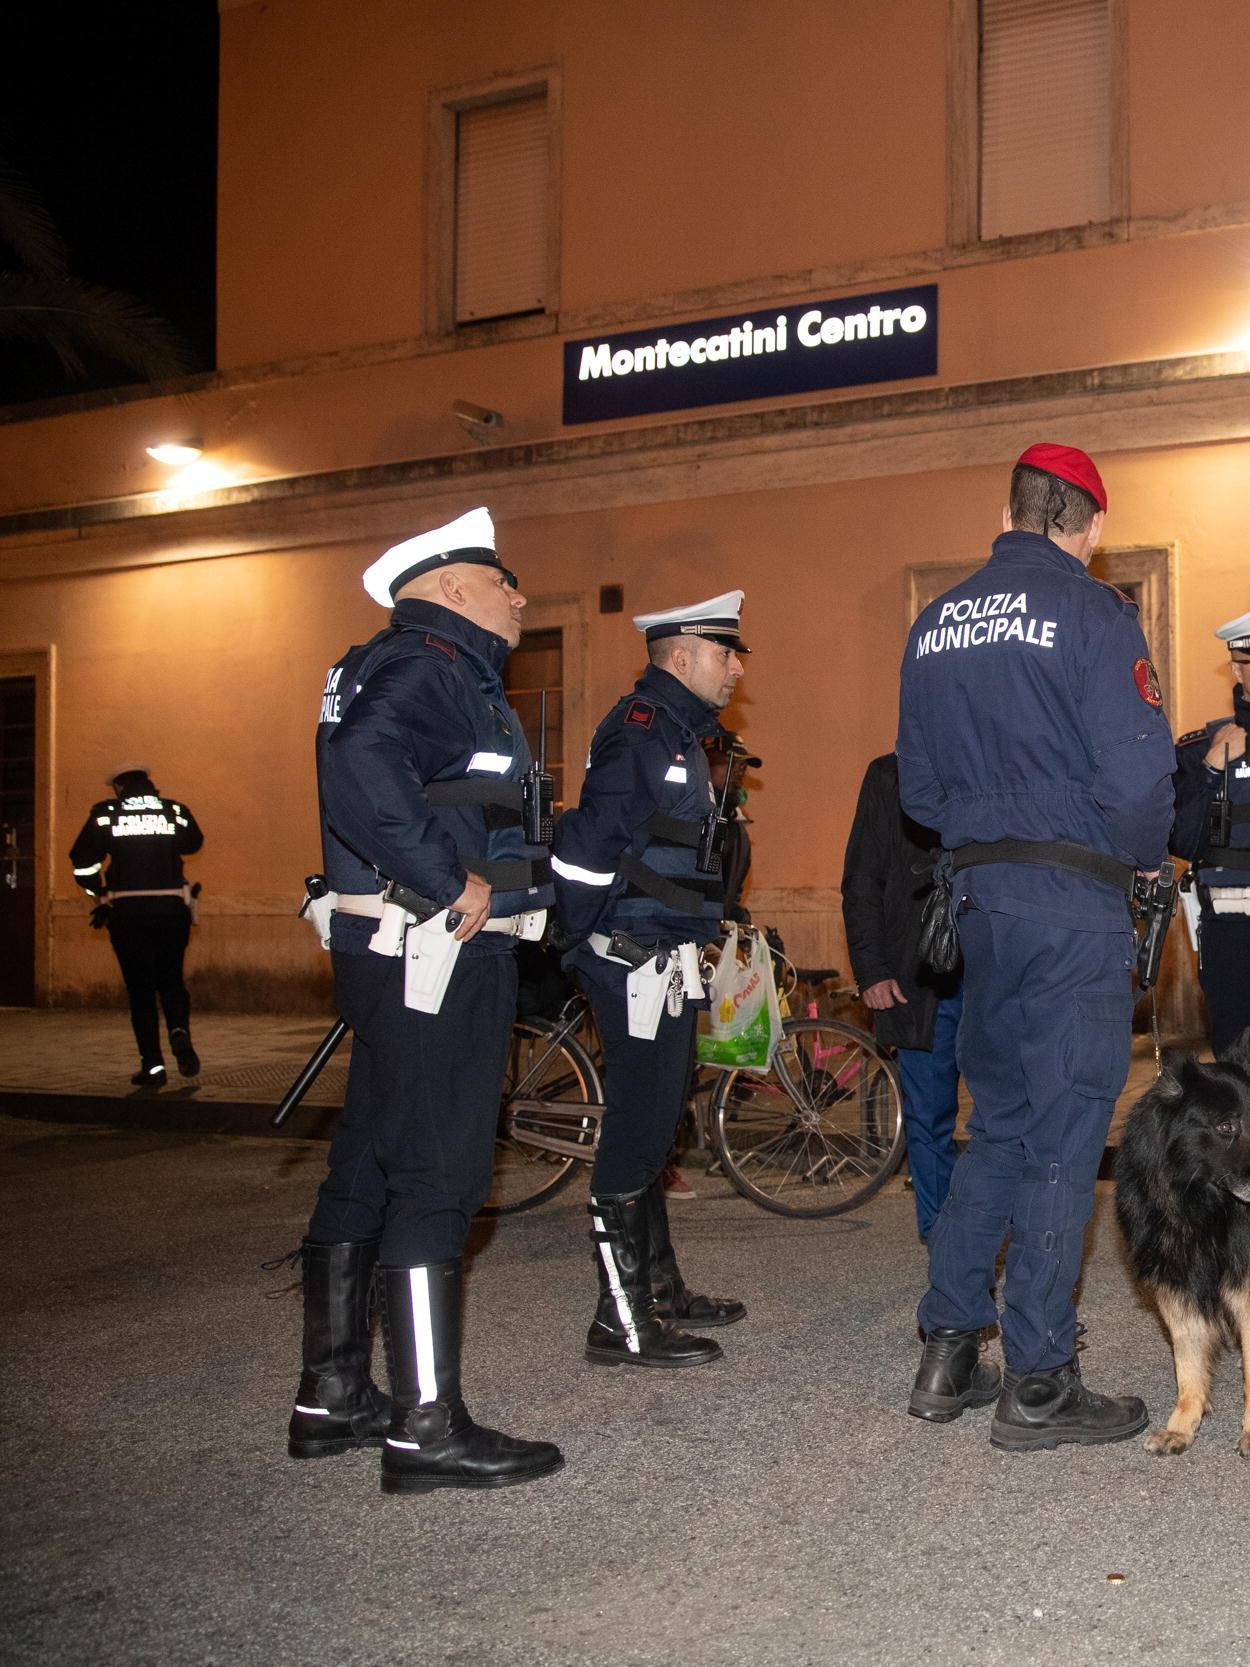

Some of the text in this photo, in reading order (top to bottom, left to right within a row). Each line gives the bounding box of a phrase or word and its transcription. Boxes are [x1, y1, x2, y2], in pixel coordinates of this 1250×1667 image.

[578, 304, 928, 381] Montecatini Centro
[938, 592, 1027, 625] POLIZIA
[916, 616, 1057, 660] MUNICIPALE
